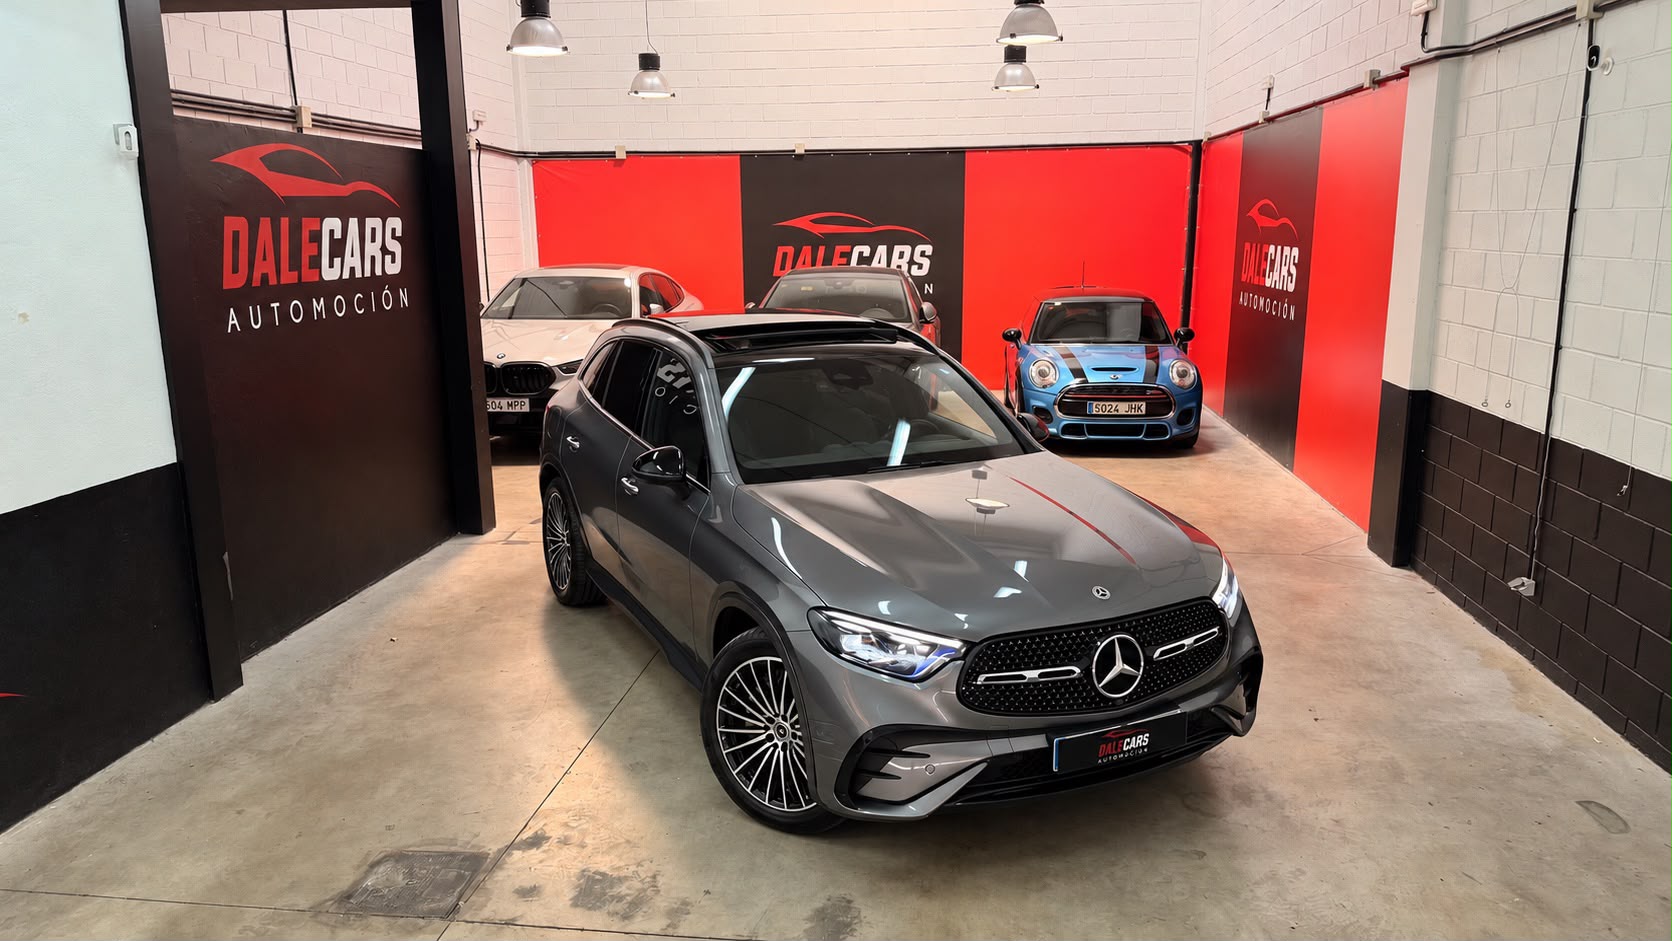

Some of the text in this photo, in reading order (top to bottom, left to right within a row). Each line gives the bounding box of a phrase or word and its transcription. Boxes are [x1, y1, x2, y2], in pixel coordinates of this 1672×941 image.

[223, 216, 402, 289] DALECARS
[1241, 242, 1299, 293] DALECARS
[227, 285, 409, 333] AUTOMOCIÓN
[1239, 291, 1295, 320] AUTOMOCIÓN
[507, 400, 526, 410] MPP
[1124, 403, 1144, 413] JHK
[1098, 733, 1150, 757] DALECARS
